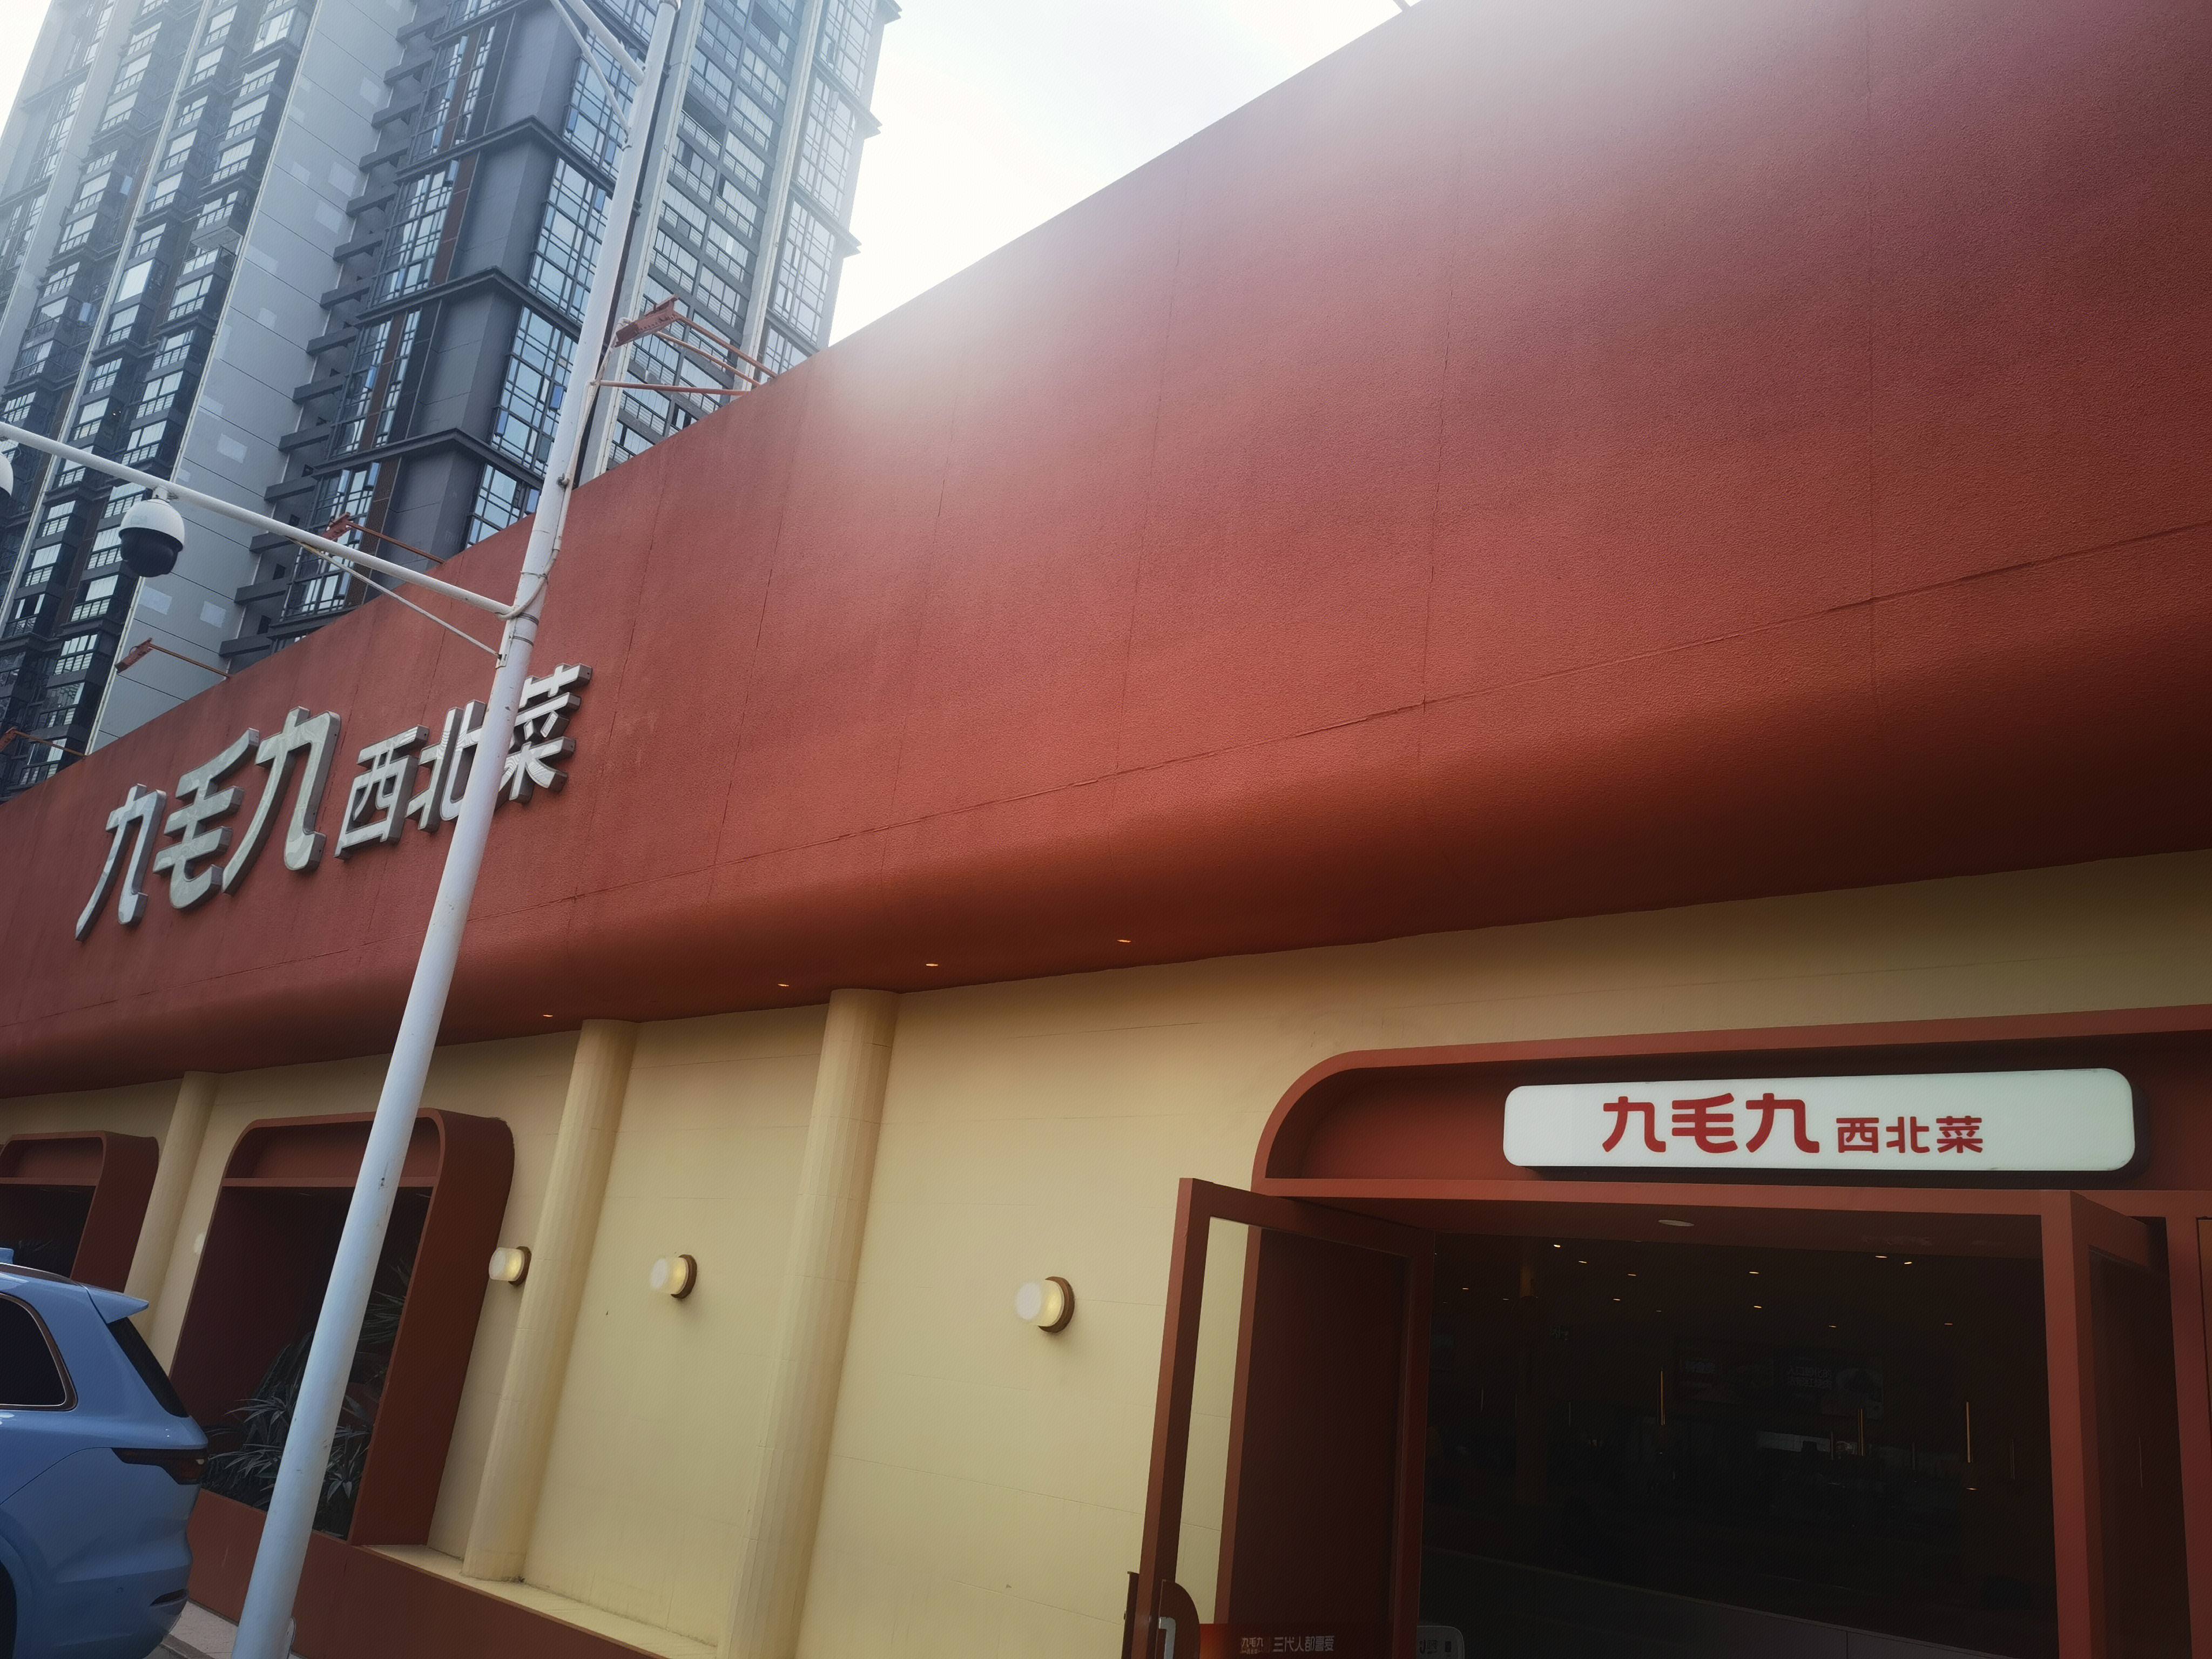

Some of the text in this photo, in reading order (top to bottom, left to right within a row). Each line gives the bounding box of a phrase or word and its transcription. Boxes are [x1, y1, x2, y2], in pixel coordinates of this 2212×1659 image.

[75, 706, 341, 942] 九毛九
[1601, 1092, 1984, 1154] 九毛九 西北菜
